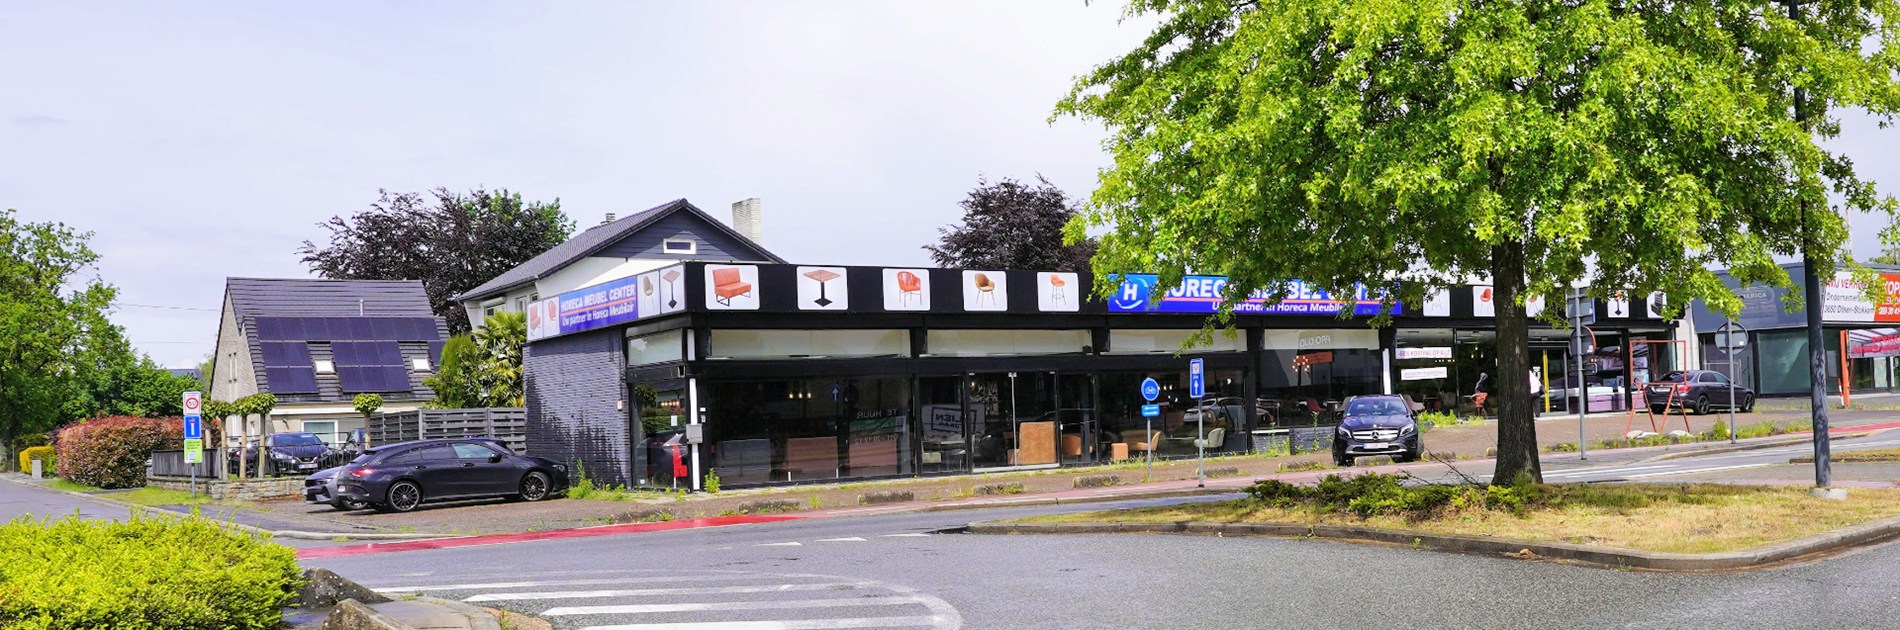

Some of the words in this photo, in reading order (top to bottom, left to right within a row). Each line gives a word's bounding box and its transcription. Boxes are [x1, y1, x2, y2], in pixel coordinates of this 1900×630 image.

[561, 297, 583, 312] HORECA
[584, 292, 608, 306] MEUBEL
[609, 284, 636, 300] CENTER
[1123, 283, 1138, 301] H
[562, 317, 571, 327] Uw
[571, 314, 587, 327] partner
[592, 308, 609, 319] Horeca
[609, 302, 635, 316] Meubilair
[1277, 303, 1308, 312] Horeca
